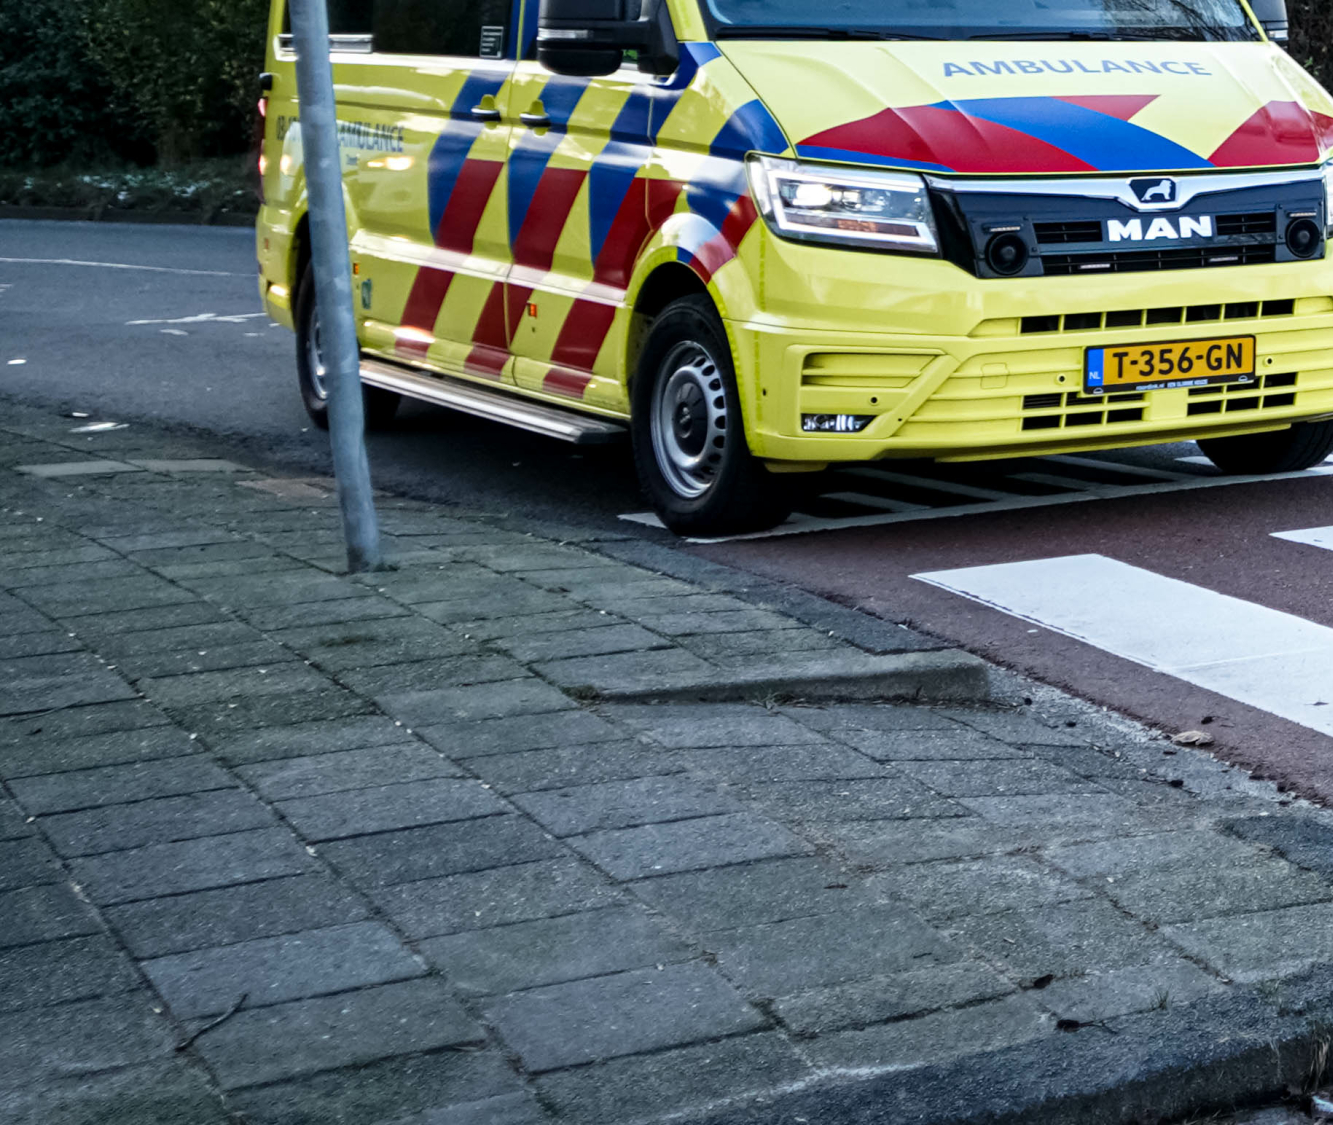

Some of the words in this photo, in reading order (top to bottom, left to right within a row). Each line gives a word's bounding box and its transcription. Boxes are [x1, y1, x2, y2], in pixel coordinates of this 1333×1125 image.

[943, 59, 1212, 77] AMBULANCE
[1107, 215, 1212, 242] MAN
[1089, 371, 1101, 380] NL
[1112, 342, 1243, 379] T-356-GN
